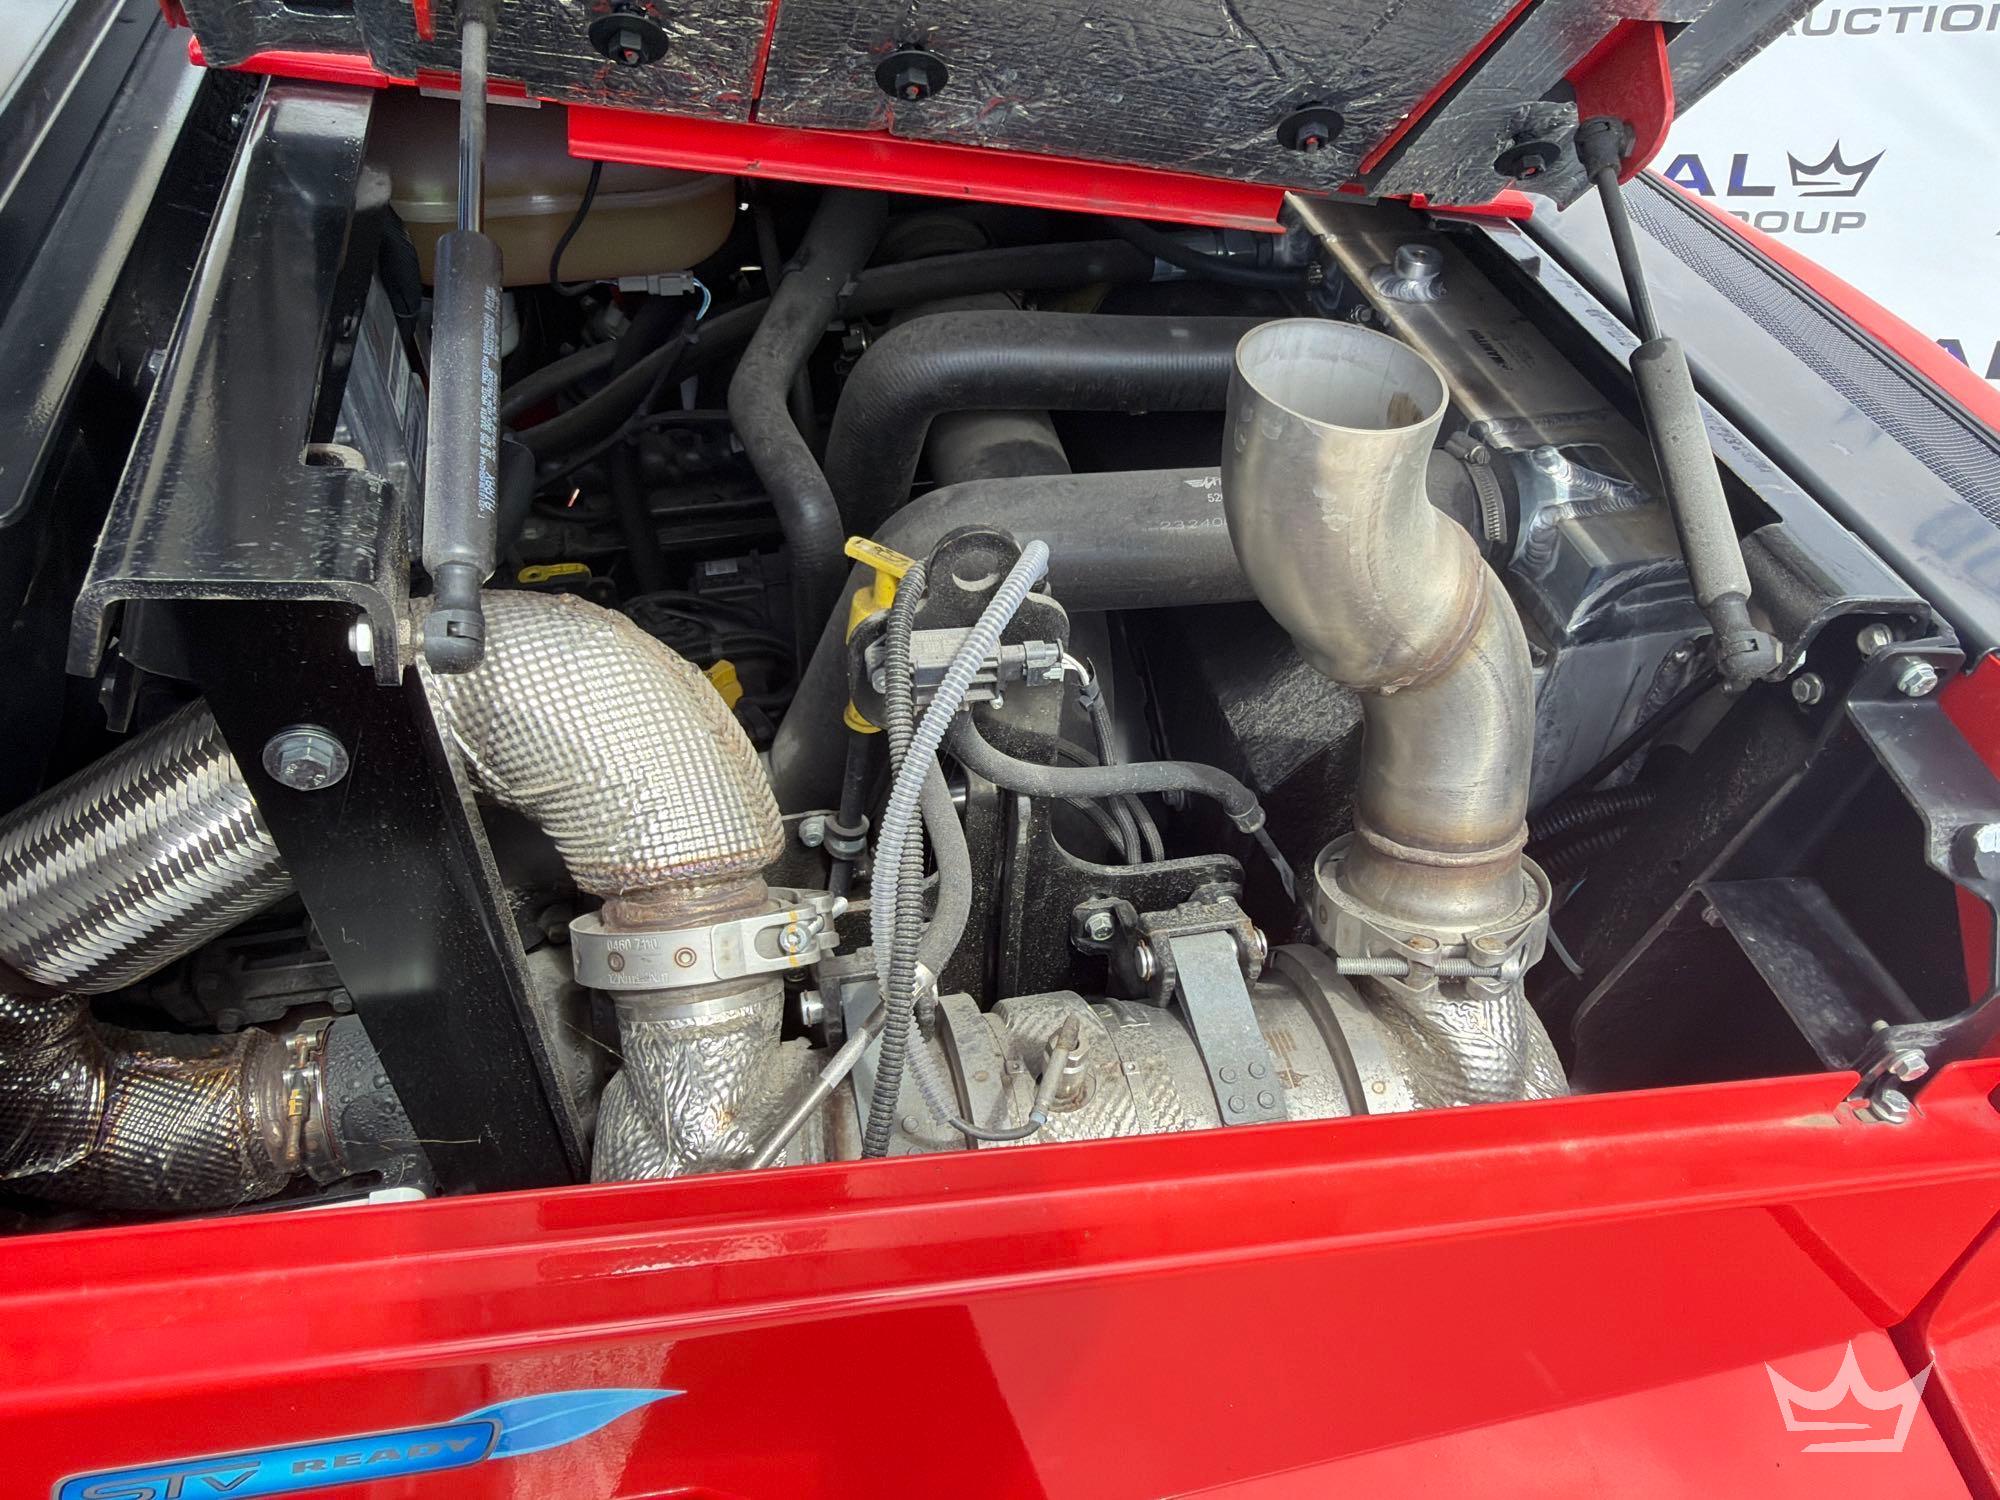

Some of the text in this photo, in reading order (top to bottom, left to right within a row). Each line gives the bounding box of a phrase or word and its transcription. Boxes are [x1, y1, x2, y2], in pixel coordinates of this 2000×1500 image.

[1787, 3, 2000, 36] UCTIO
[1663, 153, 1776, 196] AL
[1207, 492, 1223, 503] 52
[81, 1436, 478, 1500] STV READY
